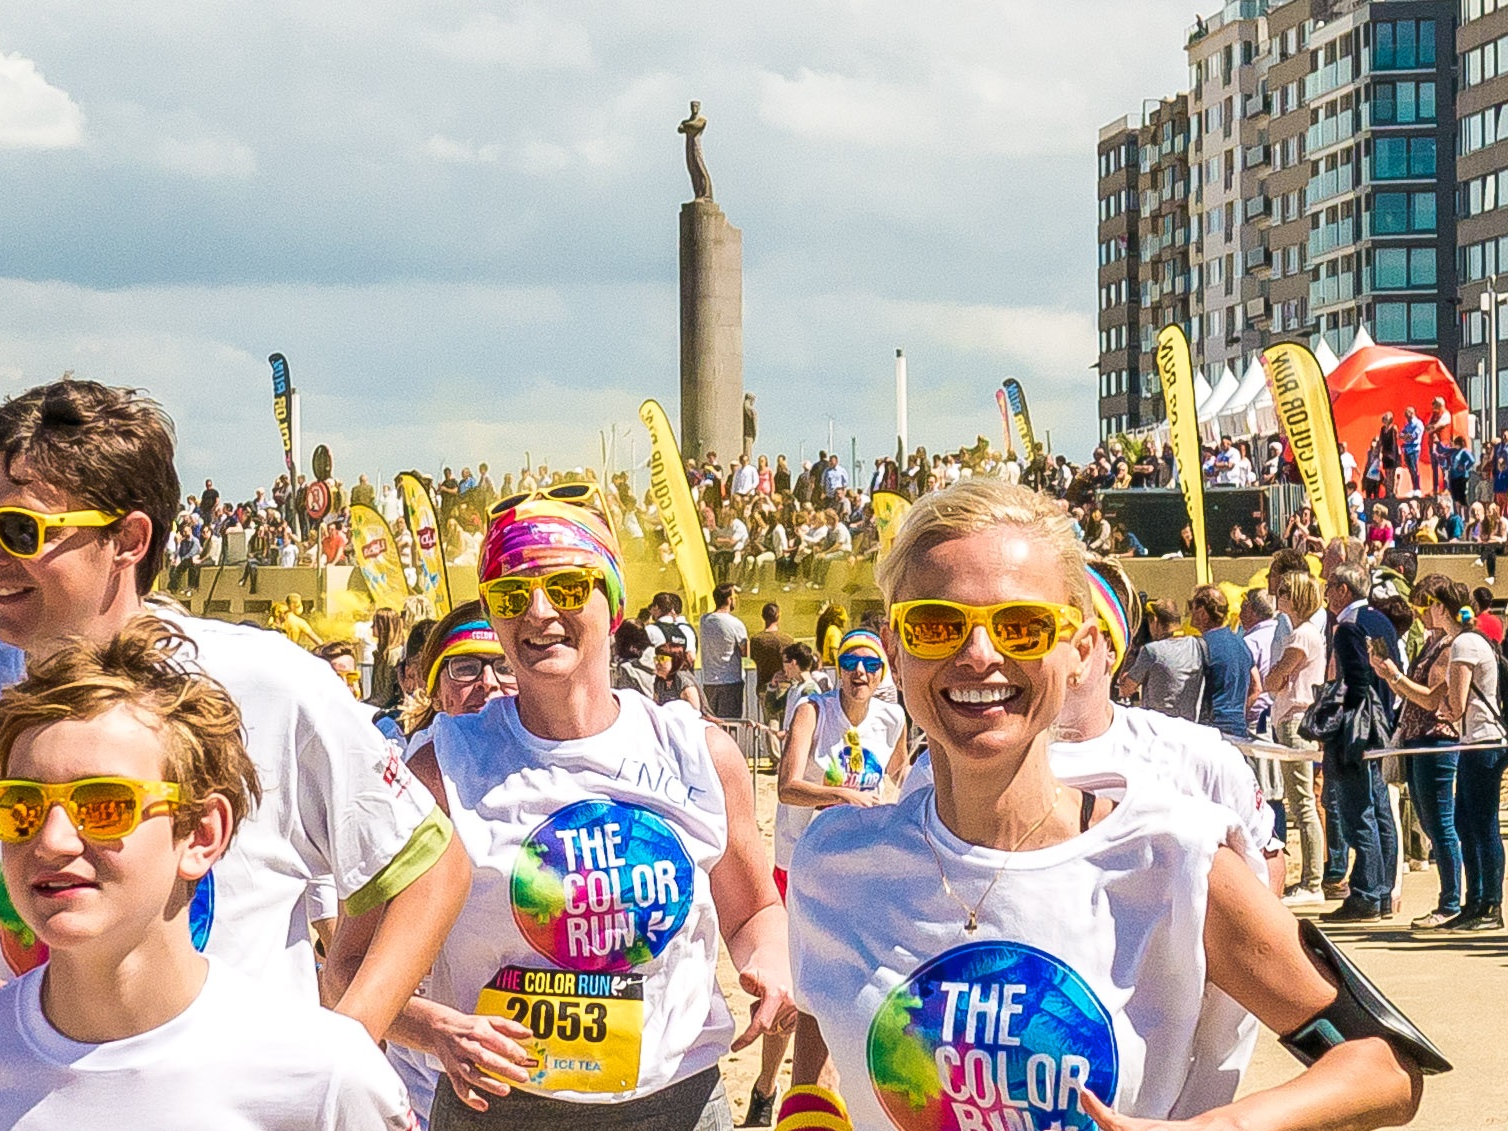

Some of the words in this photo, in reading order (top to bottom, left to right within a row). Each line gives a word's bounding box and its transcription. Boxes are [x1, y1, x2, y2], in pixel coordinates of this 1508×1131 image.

[555, 823, 626, 872] THE
[562, 859, 680, 916] COLOR
[566, 911, 636, 958] RUN
[496, 969, 522, 991] THE
[524, 971, 576, 996] COLOR
[577, 974, 611, 997] RUN
[506, 996, 608, 1044] 2053
[940, 981, 1027, 1047] THE
[553, 1059, 574, 1070] ICE
[578, 1059, 602, 1072] TEA
[934, 1046, 1091, 1113] COLOR
